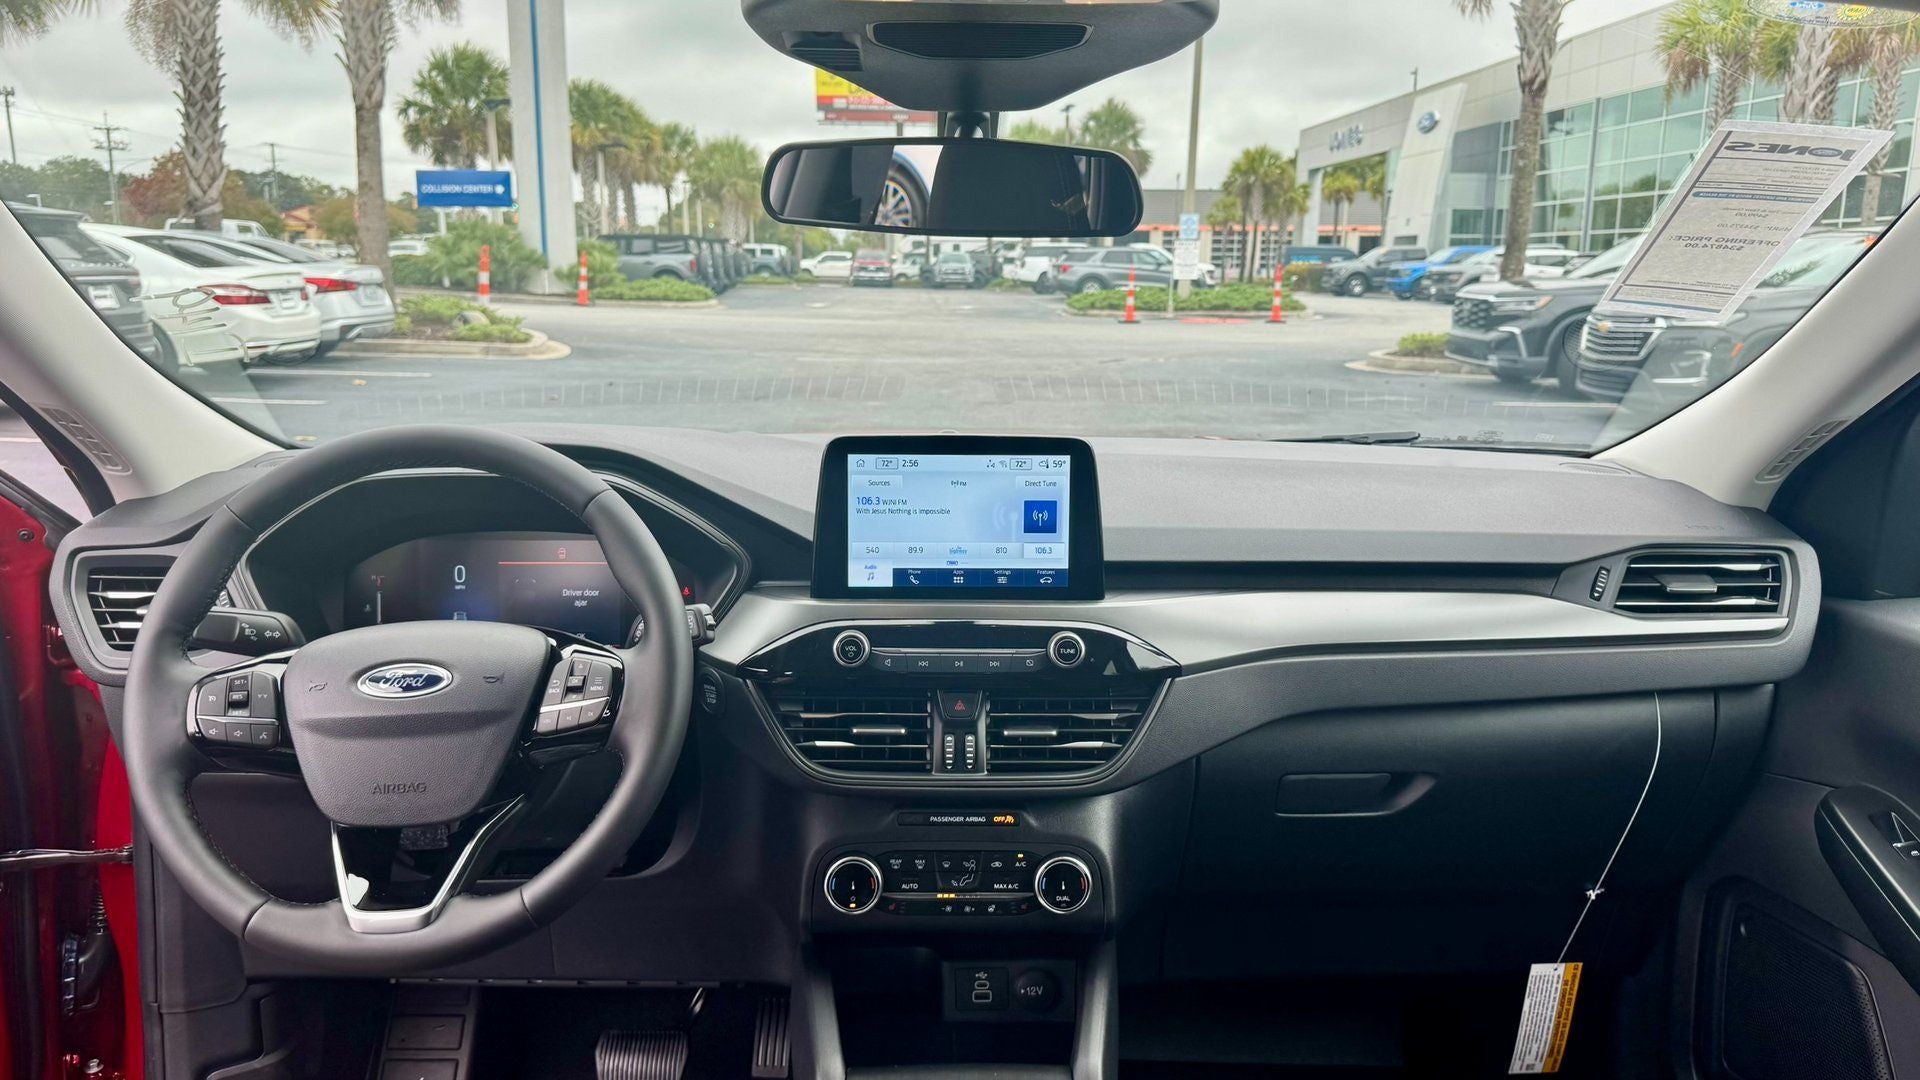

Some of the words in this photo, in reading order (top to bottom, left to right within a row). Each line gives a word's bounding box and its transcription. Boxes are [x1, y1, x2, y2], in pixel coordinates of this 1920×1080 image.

[421, 184, 461, 194] COLLISION
[462, 184, 494, 194] CENTER
[880, 459, 893, 468] 72°
[902, 459, 919, 468] 2:56
[1015, 460, 1027, 468] 72°
[1052, 459, 1067, 468] 59°
[868, 479, 891, 487] Sources
[856, 496, 881, 506] 106.3
[897, 498, 907, 506] FM
[856, 507, 870, 515] With
[871, 507, 887, 515] Jesus
[888, 507, 911, 516] Nothing
[912, 507, 917, 515] is
[865, 546, 880, 554] 540
[907, 546, 924, 554] 89.9
[995, 546, 1008, 554] 810
[1034, 546, 1053, 554] 106.3
[454, 565, 466, 583] 0
[562, 588, 583, 597] Driver
[583, 588, 600, 597] door
[380, 669, 426, 688] Ford
[372, 783, 428, 795] AIRBAG
